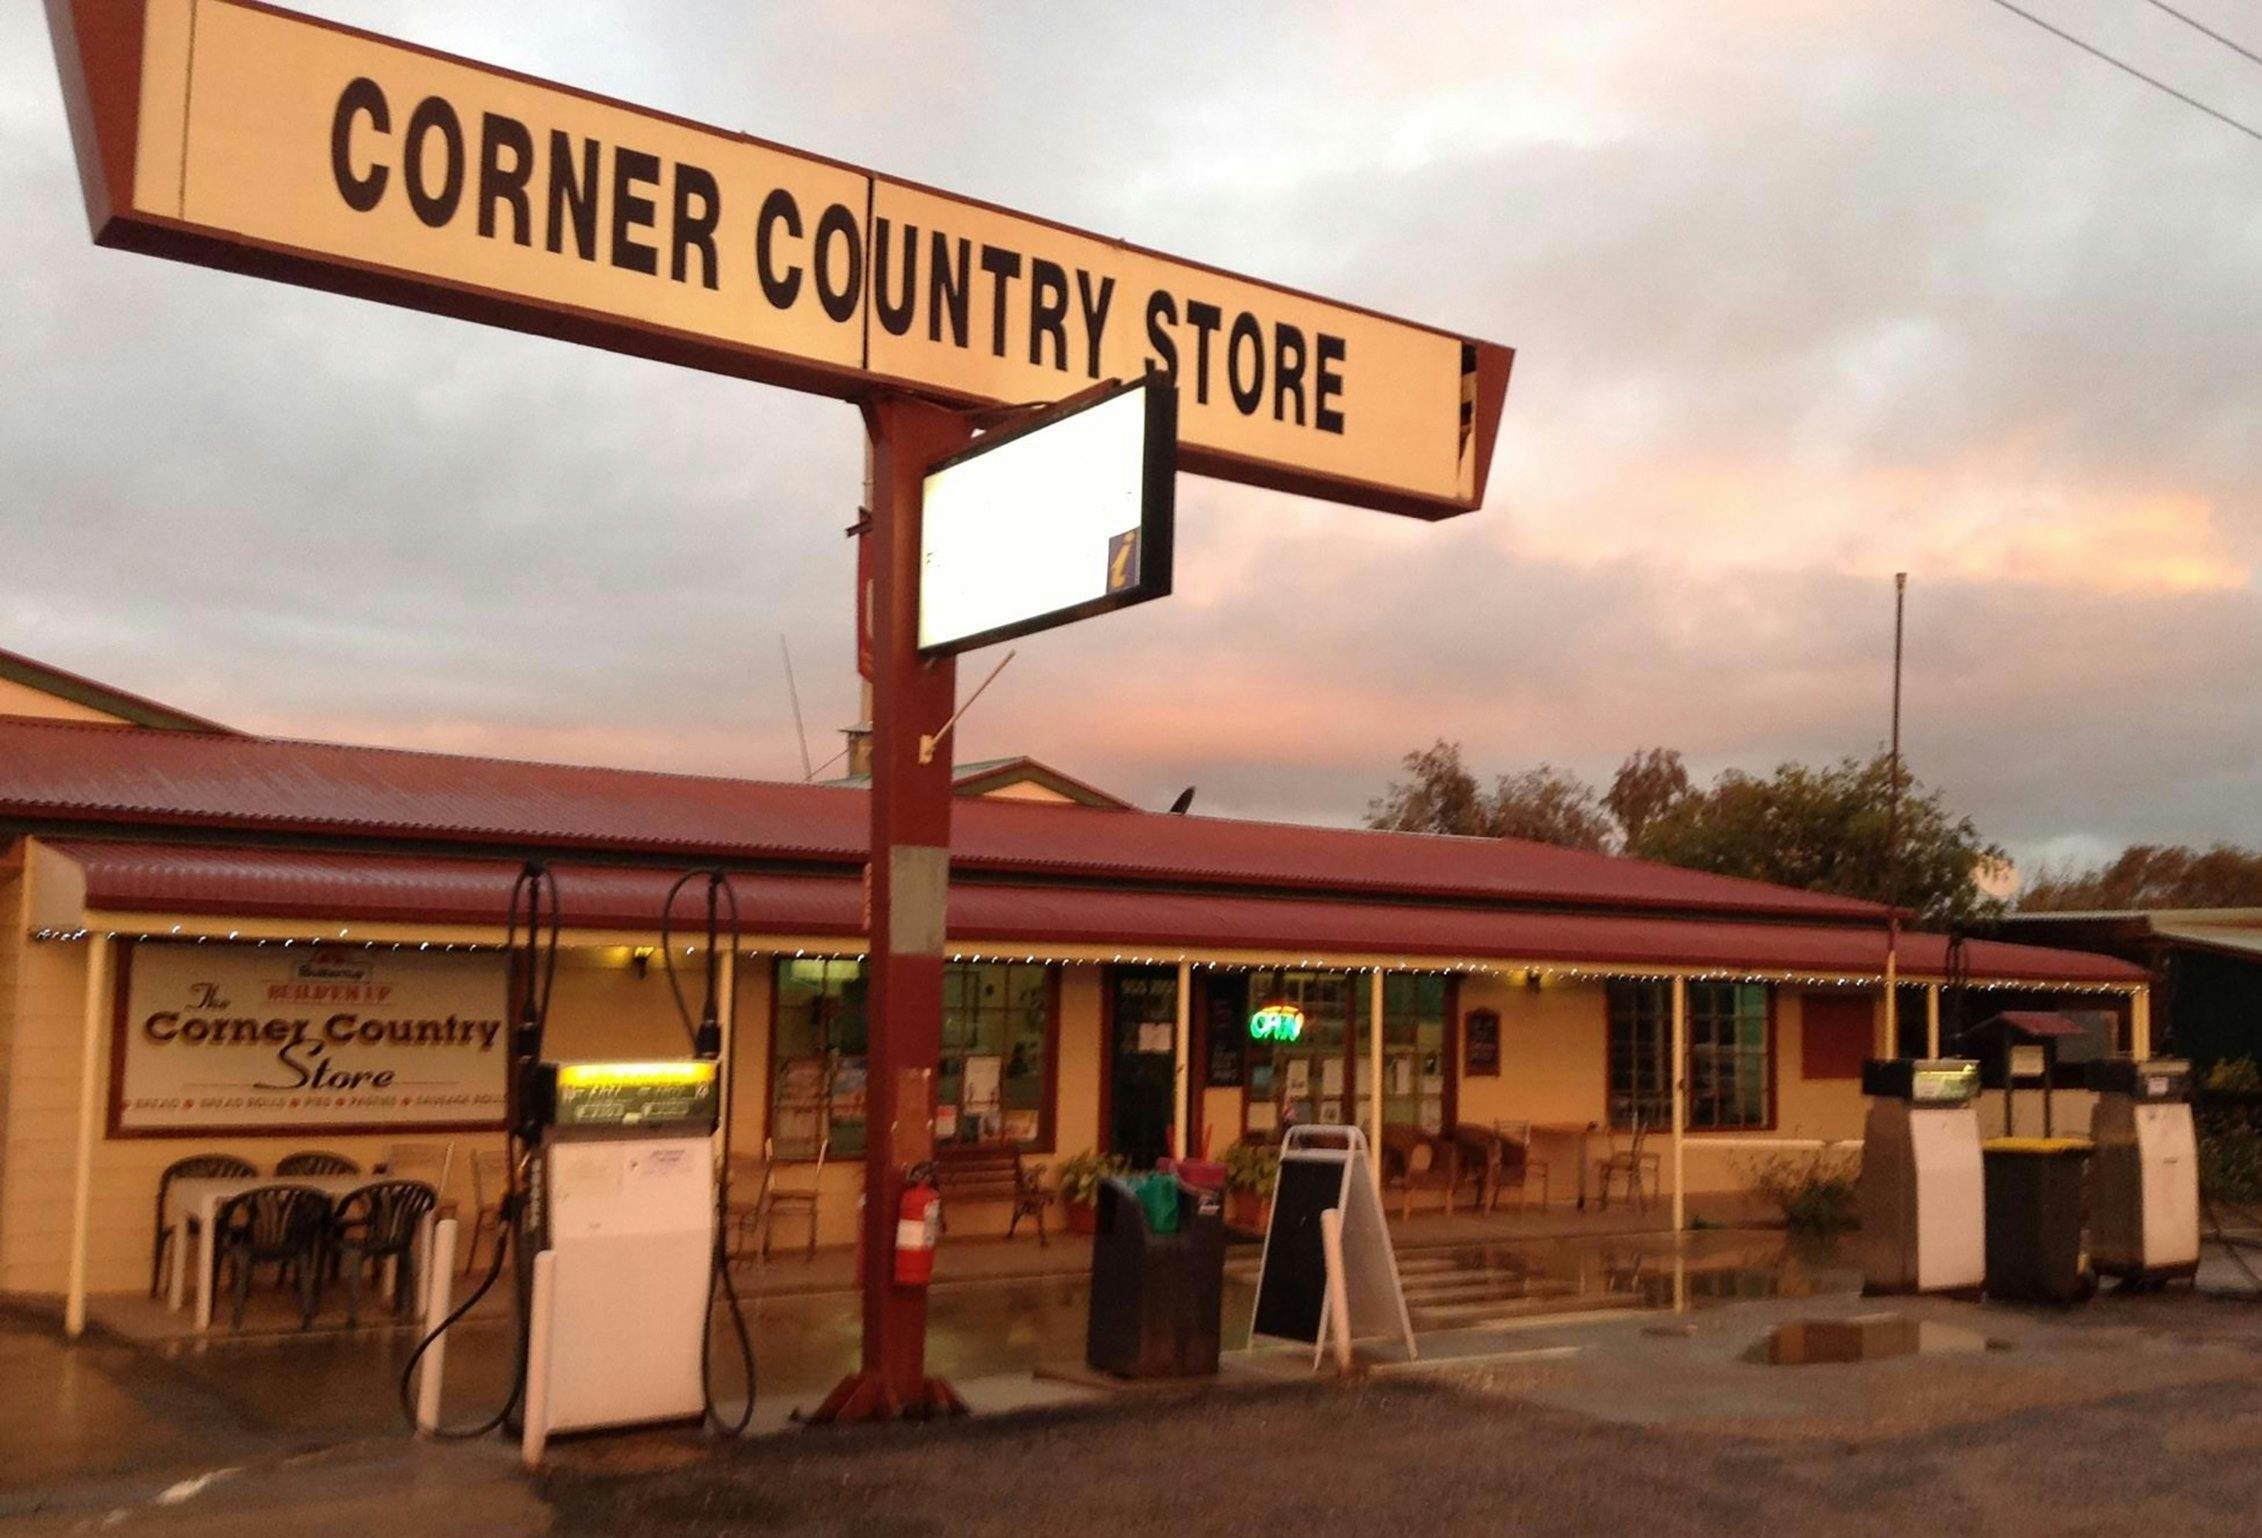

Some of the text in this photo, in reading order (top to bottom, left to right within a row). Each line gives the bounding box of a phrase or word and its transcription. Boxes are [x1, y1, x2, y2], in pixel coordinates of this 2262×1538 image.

[332, 77, 1346, 435] CORNER COUNTRY STORE
[185, 982, 232, 1010] The
[143, 1011, 503, 1052] Corner Country
[253, 1037, 398, 1090] Store
